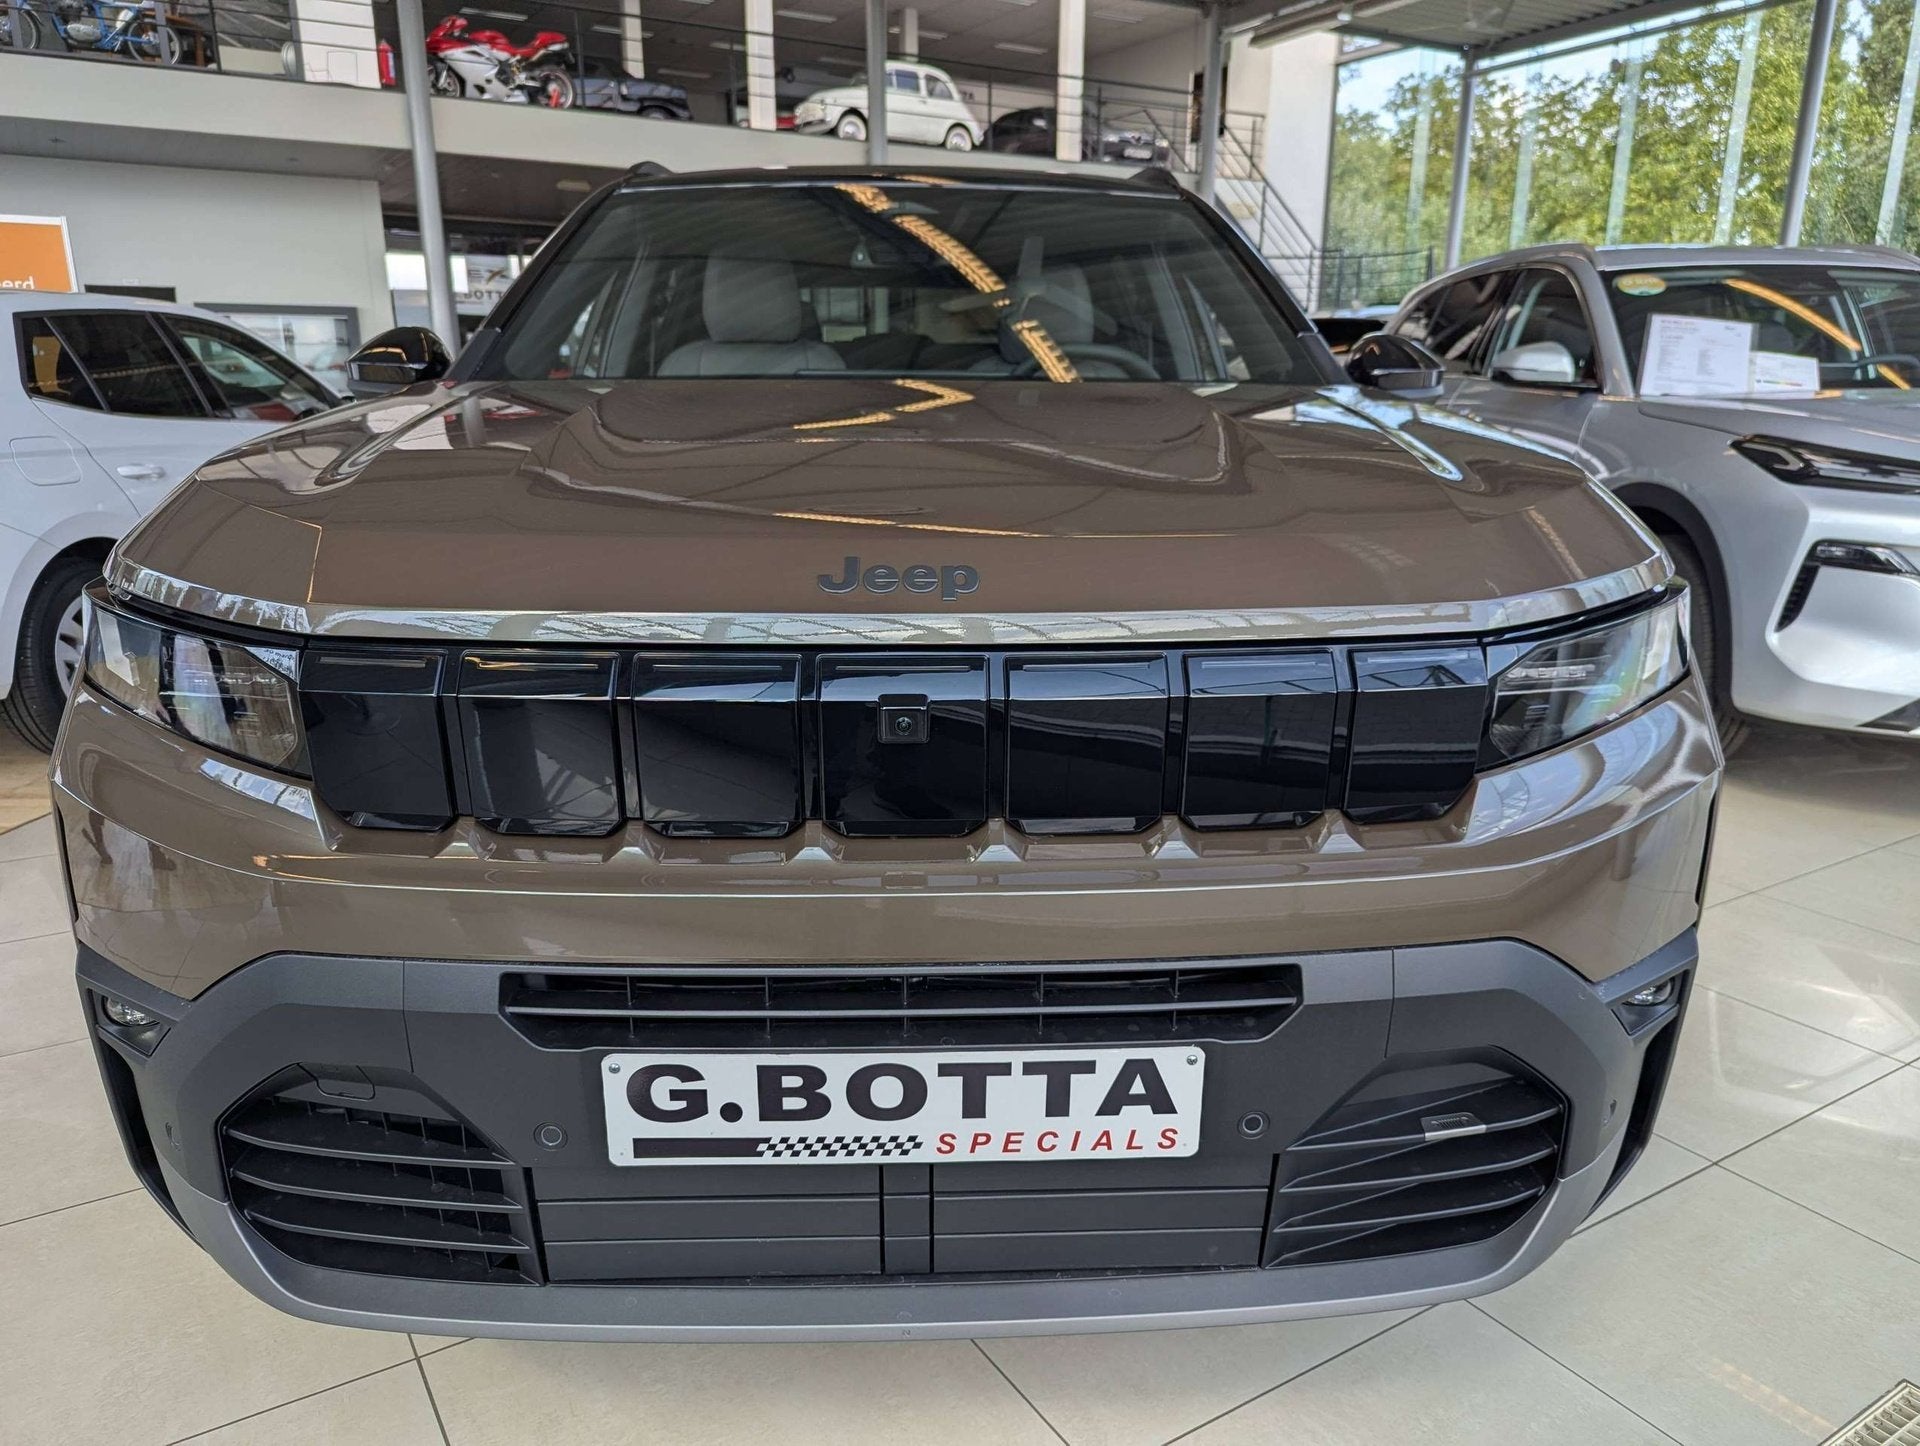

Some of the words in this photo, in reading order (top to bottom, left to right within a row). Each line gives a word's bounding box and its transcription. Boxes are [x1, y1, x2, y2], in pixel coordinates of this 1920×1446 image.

[0, 275, 35, 289] erd
[818, 556, 981, 601] Jeep
[626, 1058, 1179, 1123] G.BOTTA
[935, 1127, 1179, 1155] SPECIALS
